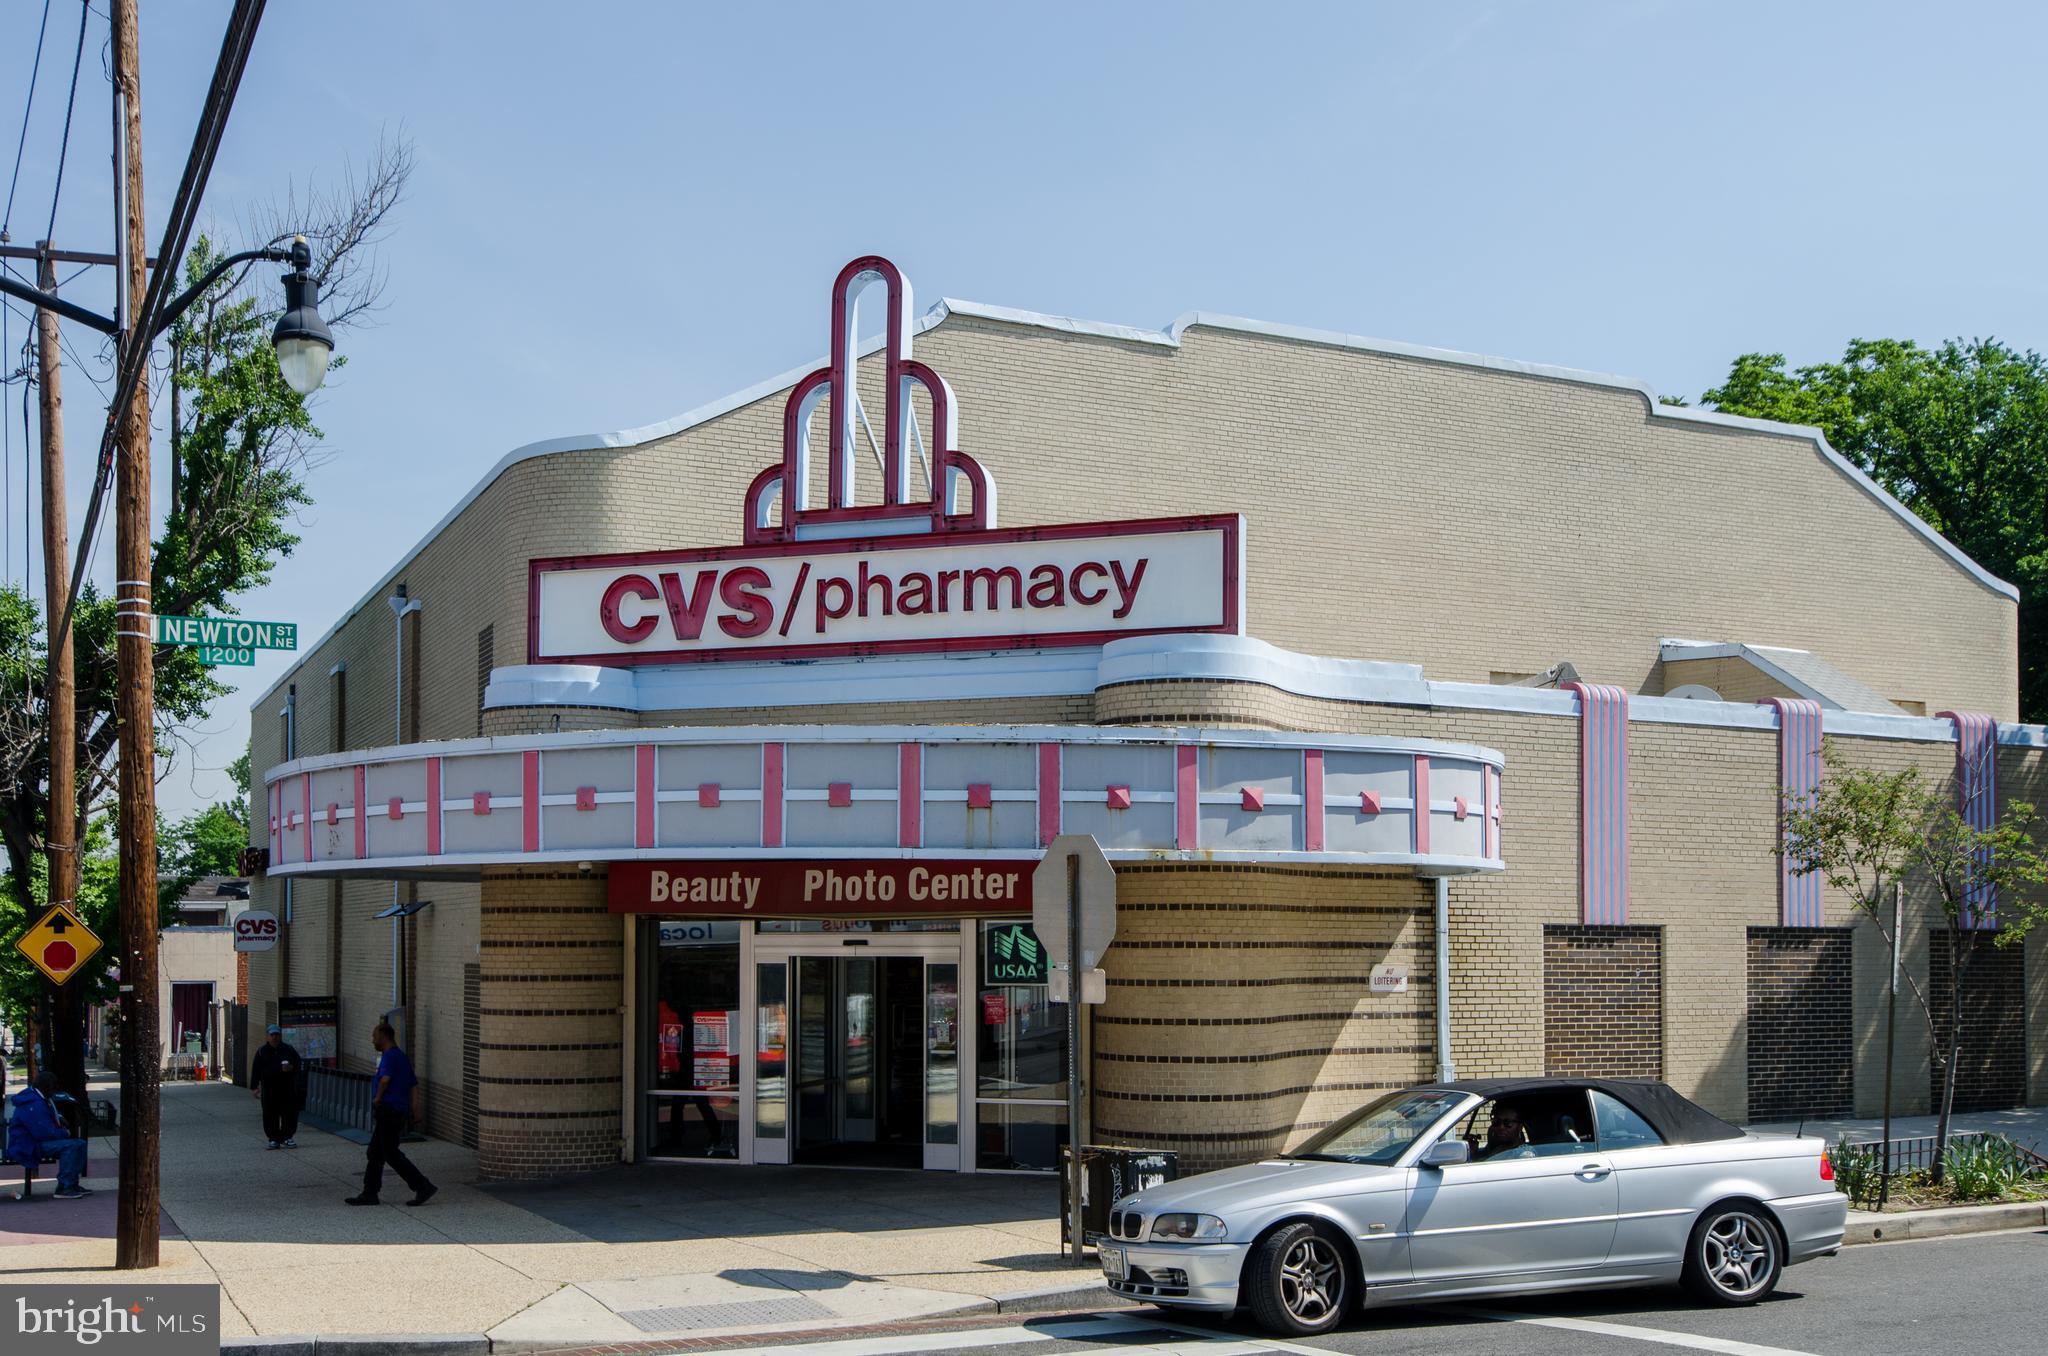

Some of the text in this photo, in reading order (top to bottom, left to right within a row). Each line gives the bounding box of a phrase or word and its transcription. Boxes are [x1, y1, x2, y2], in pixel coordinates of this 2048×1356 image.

[599, 557, 1149, 644] CVS/pharmacy
[165, 618, 294, 647] NEWTON ST
[275, 637, 294, 649] NE
[204, 646, 250, 663] 1200
[650, 867, 1020, 910] Beauty Photo Center
[236, 919, 277, 934] CVS
[237, 935, 277, 943] pharmacy
[994, 963, 1038, 978] USAA
[1374, 976, 1403, 985] LOITERING
